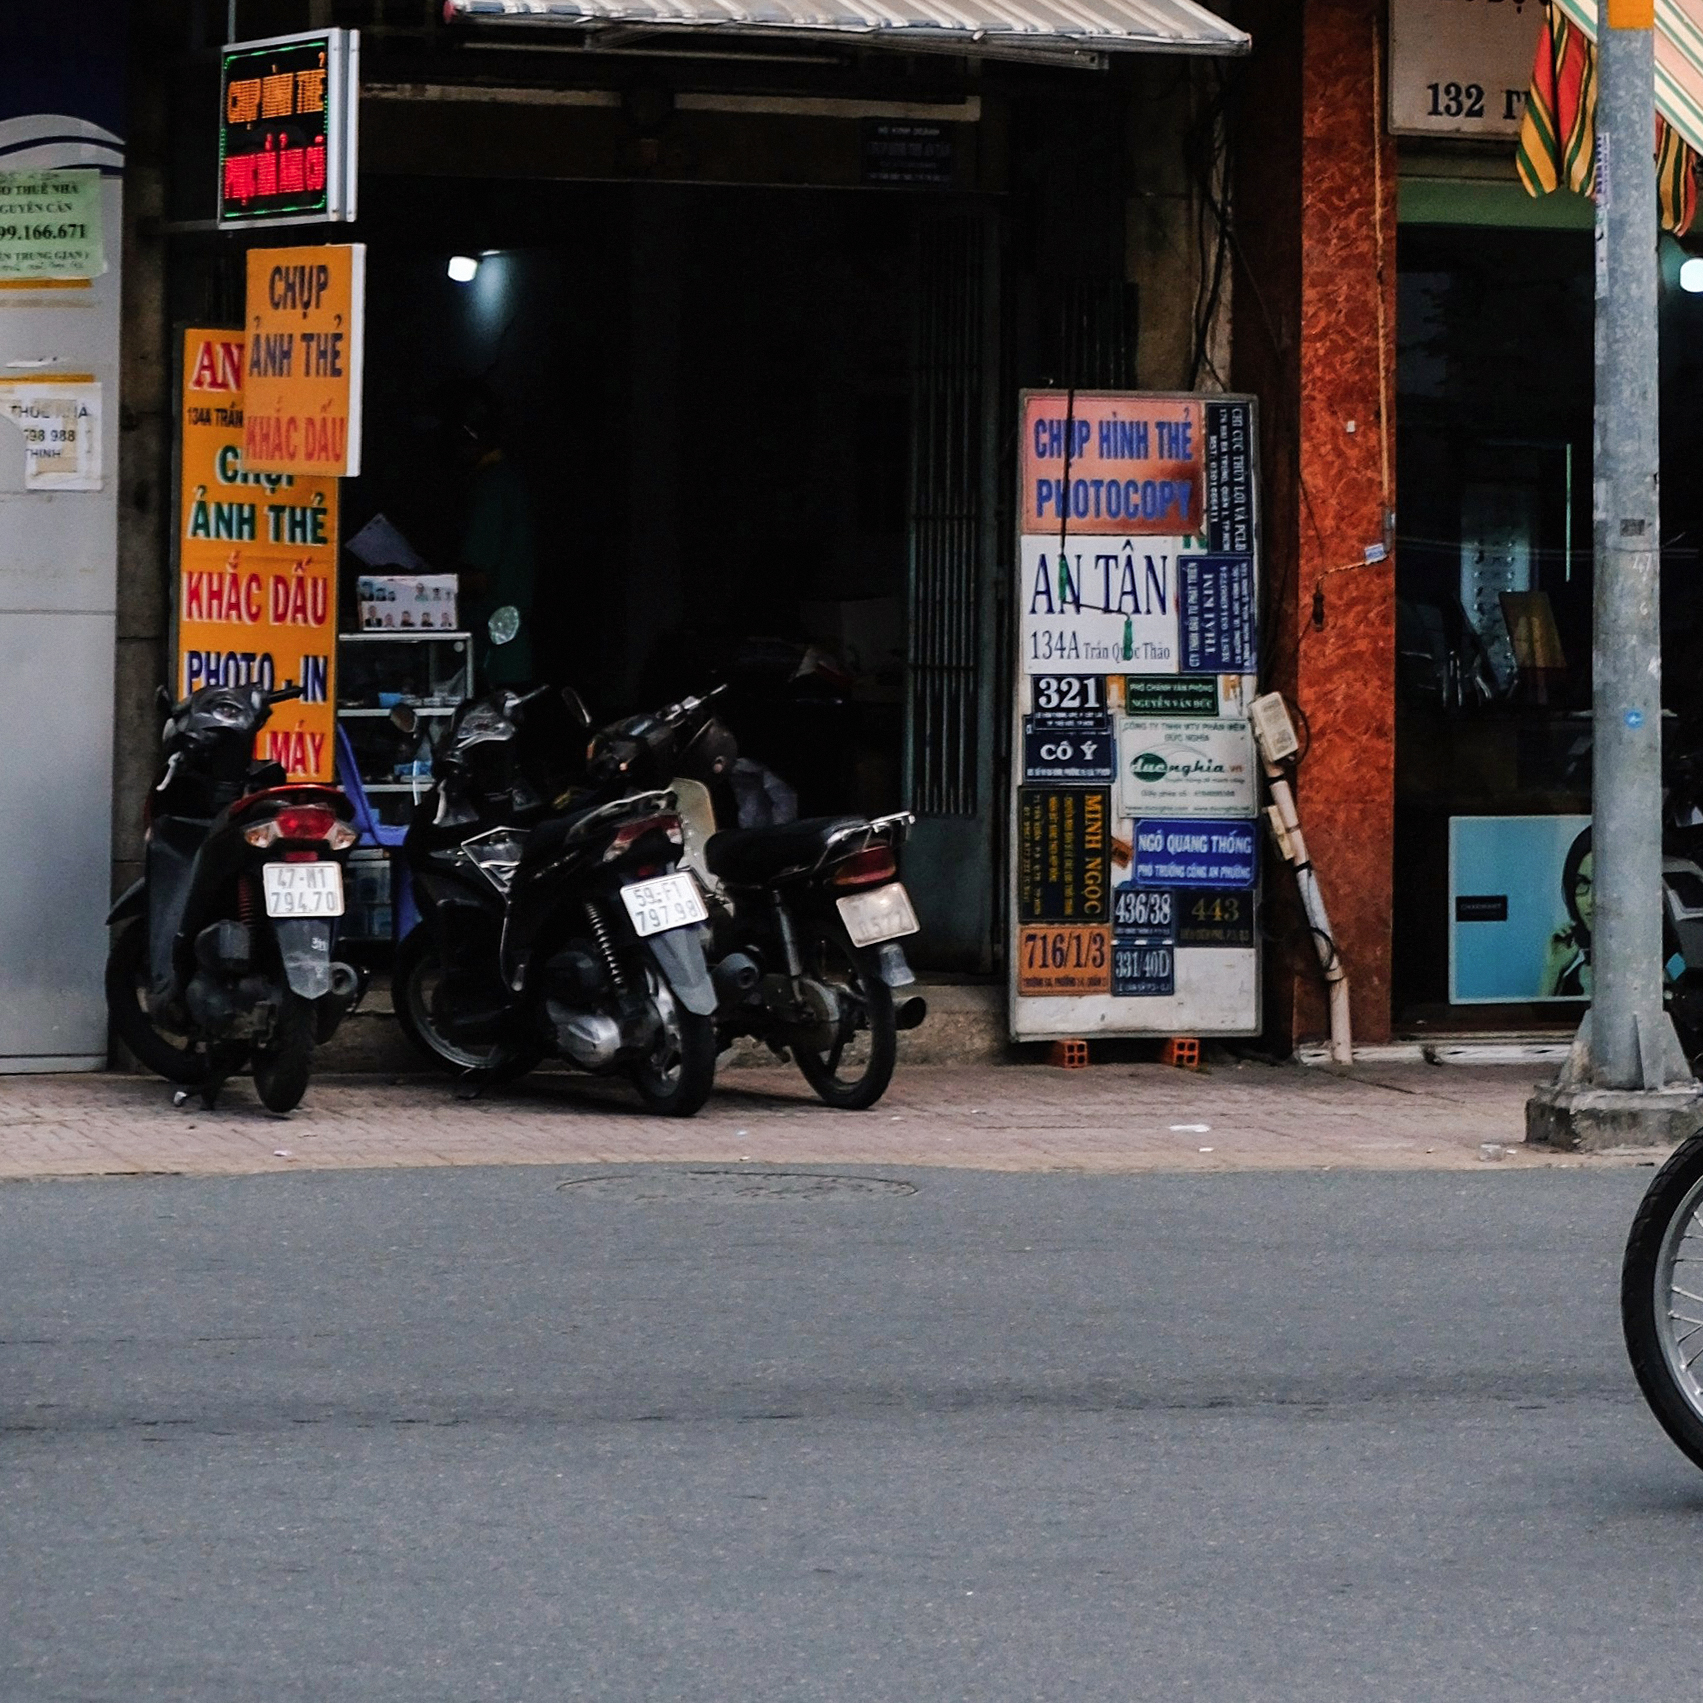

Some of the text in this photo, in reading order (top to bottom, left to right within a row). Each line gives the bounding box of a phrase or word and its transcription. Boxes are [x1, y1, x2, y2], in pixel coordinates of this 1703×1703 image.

[1426, 81, 1485, 119] 132
[268, 264, 329, 319] CHỤP
[189, 340, 245, 393] AN
[249, 313, 344, 378] ẢNH THẺ
[304, 398, 345, 462] DẤU
[1034, 407, 1194, 469] CHỤP HÌNH THẺ
[187, 485, 328, 545] ẢNH THẺ
[1036, 478, 1194, 521] PHOTOCOPY
[182, 556, 328, 628] KHẮC DẤU
[1029, 553, 1082, 615] AN
[1094, 539, 1169, 616] TÂN
[1030, 630, 1081, 660] 134A
[1112, 641, 1140, 664] Quc
[1038, 677, 1101, 710] 321
[1040, 740, 1073, 761] CÔ
[1081, 794, 1103, 914] MINH NGỌC
[1167, 833, 1208, 855] QUANG
[277, 868, 326, 889] 47-N1
[1115, 892, 1240, 924] 436/38 443
[1025, 932, 1105, 969] 716/1/3
